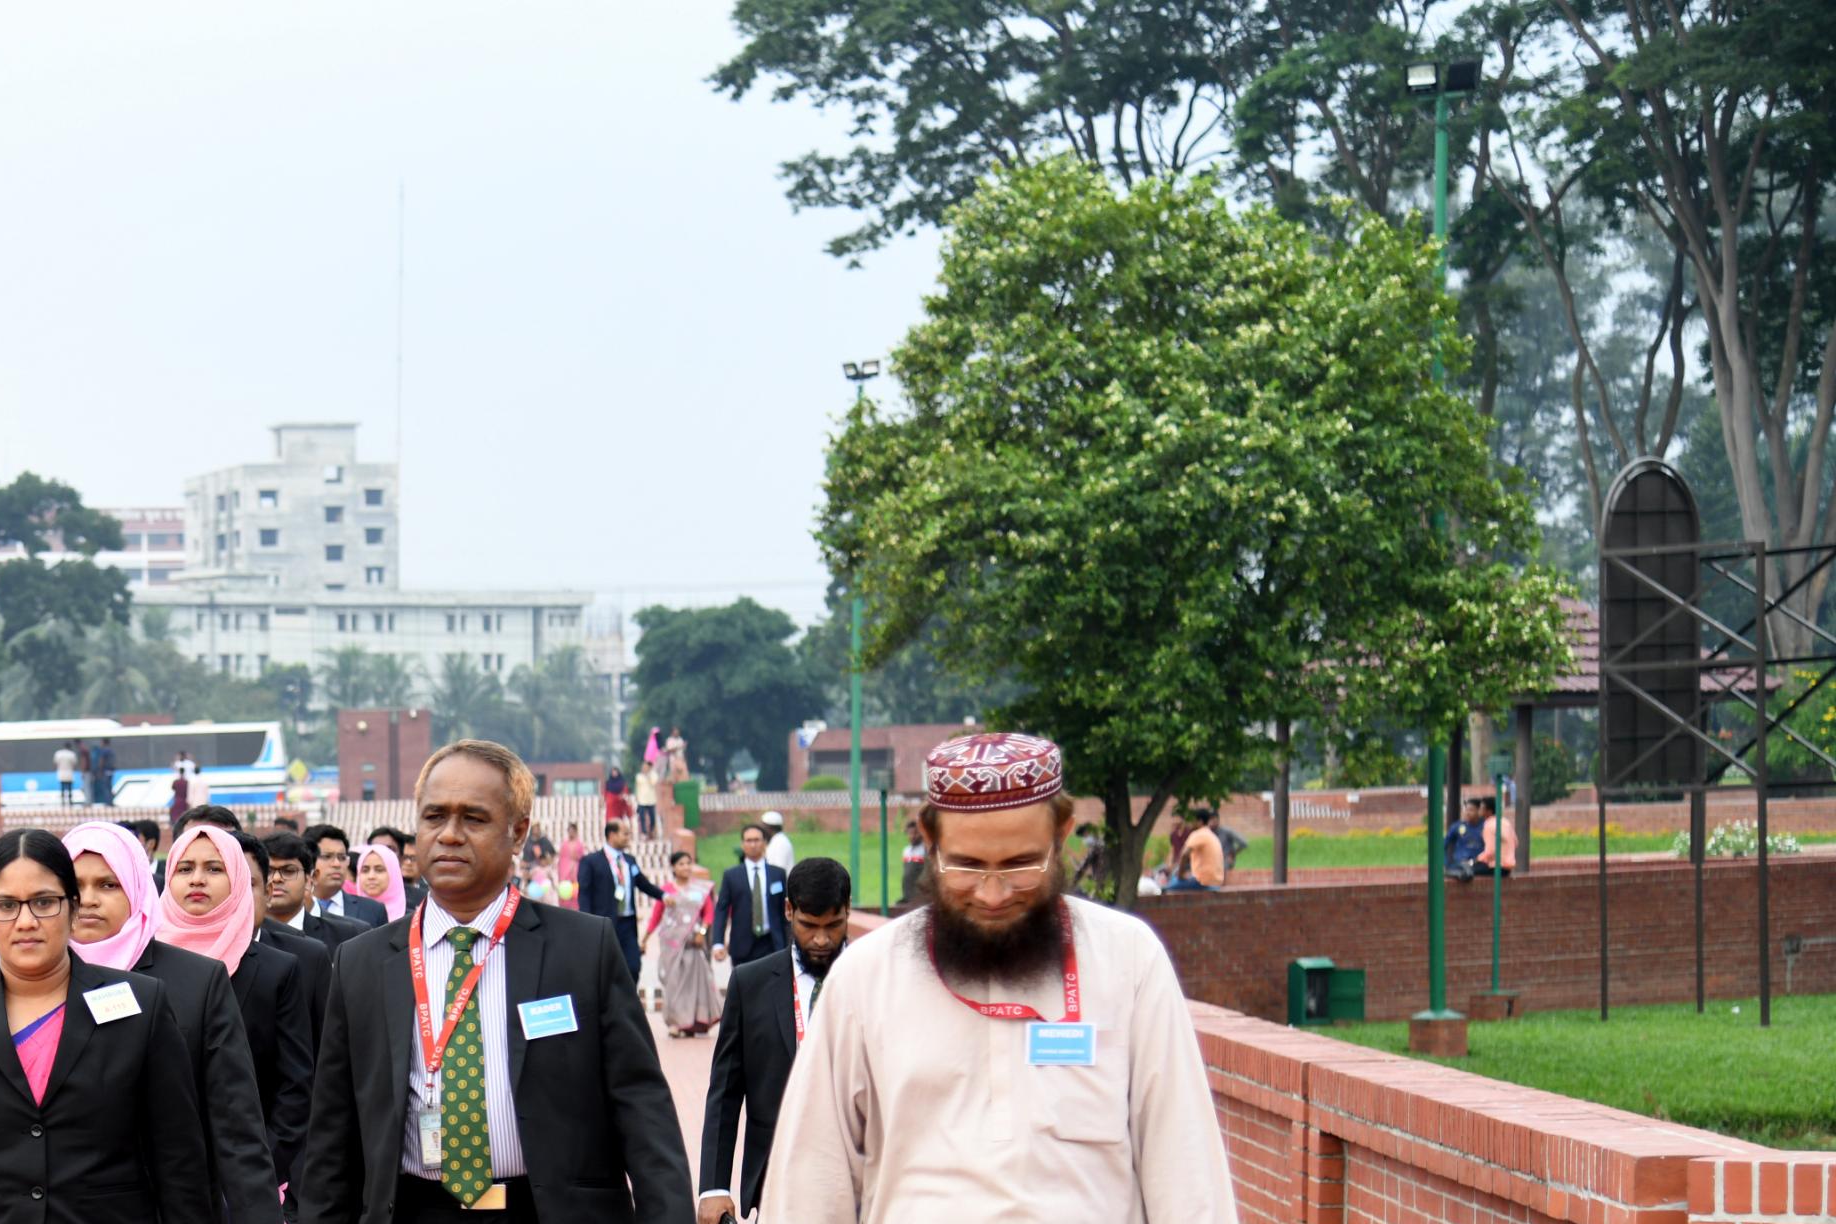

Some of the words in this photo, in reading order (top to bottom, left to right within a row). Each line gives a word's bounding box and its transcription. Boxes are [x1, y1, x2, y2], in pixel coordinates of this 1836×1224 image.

[411, 947, 423, 979] BPATC
[449, 987, 469, 1021] BPATC
[1066, 972, 1077, 1012] BPATC
[419, 1003, 431, 1037] BPATC
[980, 1005, 1023, 1016] BPATC
